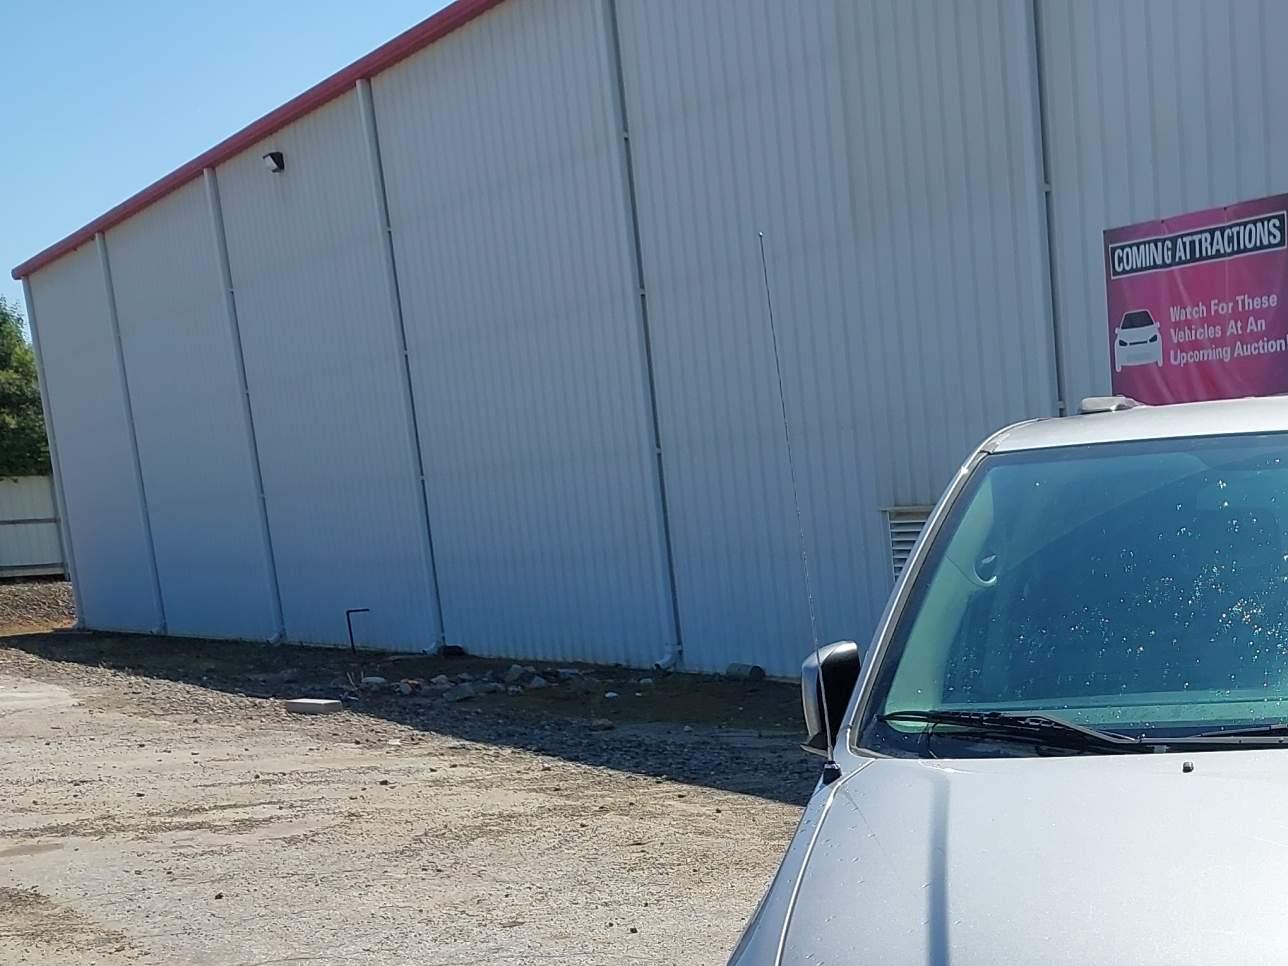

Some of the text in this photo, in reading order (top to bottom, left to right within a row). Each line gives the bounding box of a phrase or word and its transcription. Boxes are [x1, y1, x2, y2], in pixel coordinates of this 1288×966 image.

[1114, 218, 1281, 272] COMING ATTRACTIONS
[1169, 294, 1278, 322] Watch For These
[1170, 316, 1265, 343] Vehicles At An
[1169, 346, 1231, 367] Upcoming
